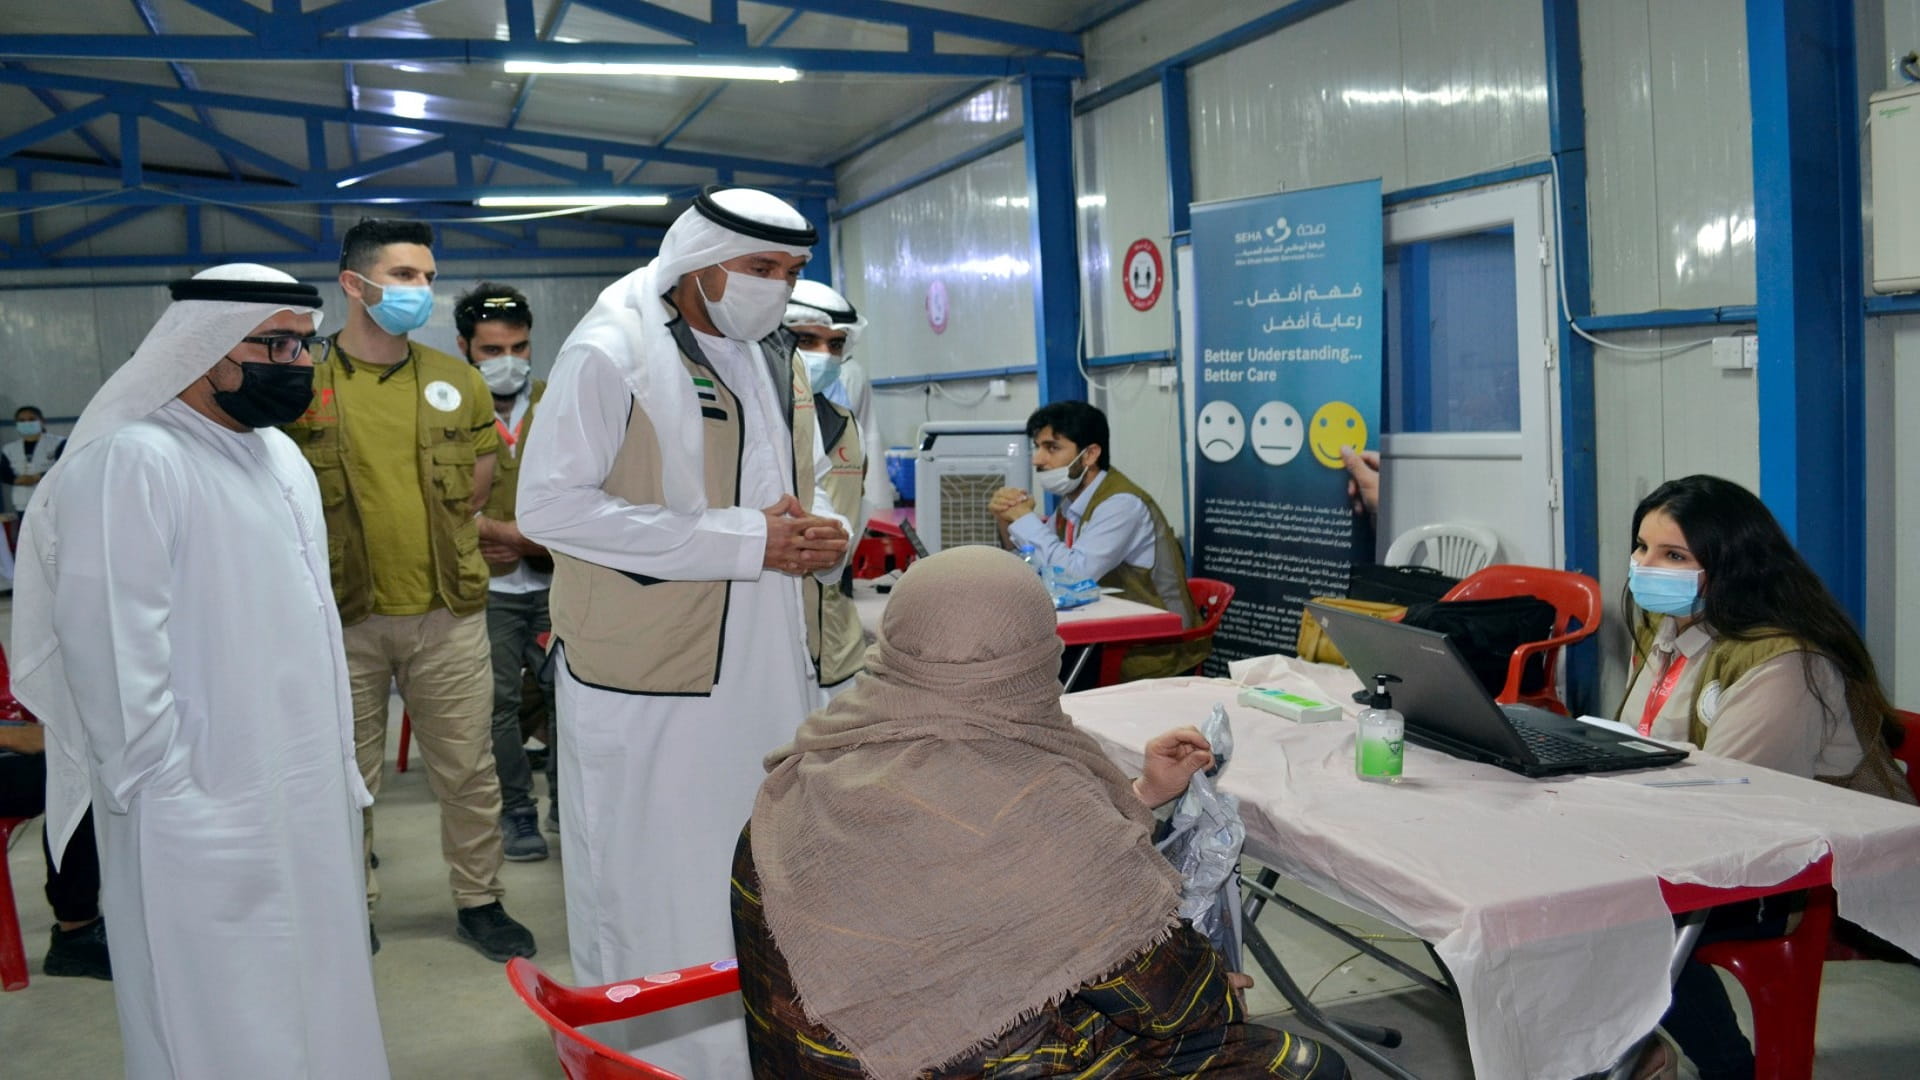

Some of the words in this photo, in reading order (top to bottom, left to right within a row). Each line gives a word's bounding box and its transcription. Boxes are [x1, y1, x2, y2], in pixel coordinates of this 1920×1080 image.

[1235, 231, 1262, 244] SEHA
[1204, 349, 1244, 364] Better
[1248, 345, 1362, 364] Understanding...
[1204, 368, 1244, 383] Better
[1247, 367, 1277, 382] Care
